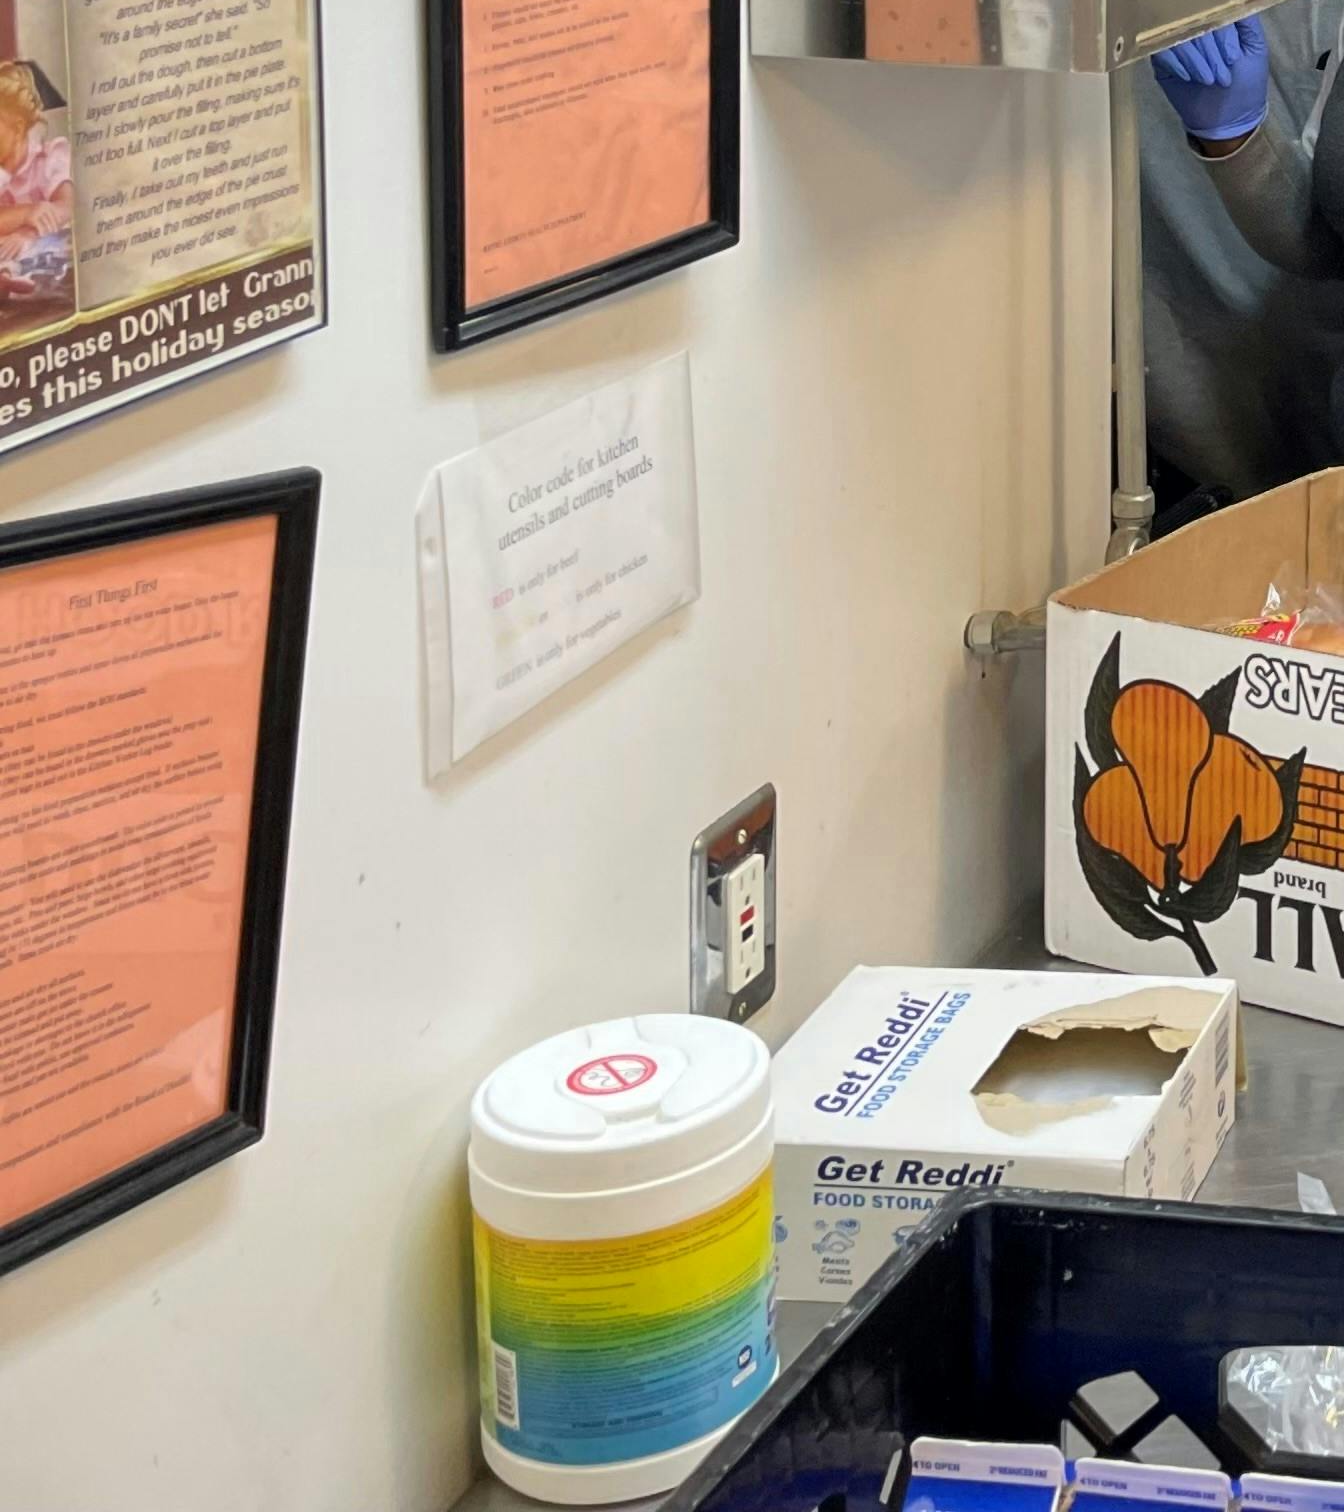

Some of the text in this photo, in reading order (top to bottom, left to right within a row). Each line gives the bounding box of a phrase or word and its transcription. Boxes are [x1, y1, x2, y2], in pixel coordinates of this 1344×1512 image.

[116, 0, 154, 20] around
[122, 30, 130, 42] a
[133, 21, 161, 39] family
[204, 9, 223, 23] she
[138, 41, 182, 63] promise
[184, 34, 201, 48] not
[203, 33, 214, 45] to
[98, 76, 116, 93] roll
[118, 73, 135, 89] out
[138, 70, 154, 84] the
[196, 54, 219, 70] then
[221, 48, 237, 63] cut
[248, 39, 282, 56] bottom
[86, 102, 115, 121] layer
[117, 95, 139, 112] and
[141, 84, 183, 106] carefully
[186, 78, 204, 96] put
[225, 71, 241, 84] the
[242, 66, 258, 81] pie
[30, 331, 112, 389] please
[120, 294, 192, 343] DON'T
[199, 284, 229, 315] let
[43, 370, 102, 408] this
[112, 323, 224, 382] holiday
[508, 436, 638, 513] Color code for kitchen
[498, 455, 653, 550] utensils and cutting boards
[546, 563, 559, 578] for
[68, 578, 159, 610] First Things First
[1273, 870, 1327, 899] brand
[814, 997, 930, 1113] Get Reddi
[856, 992, 971, 1118] FOOD STORAGE BAGS
[817, 1155, 1005, 1187] Get Reddi
[813, 1192, 936, 1210] FOOD STORA
[921, 1462, 960, 1472] TO OPEN
[1087, 1478, 1127, 1490] TO OPEN
[1265, 1495, 1292, 1504] OPEN
